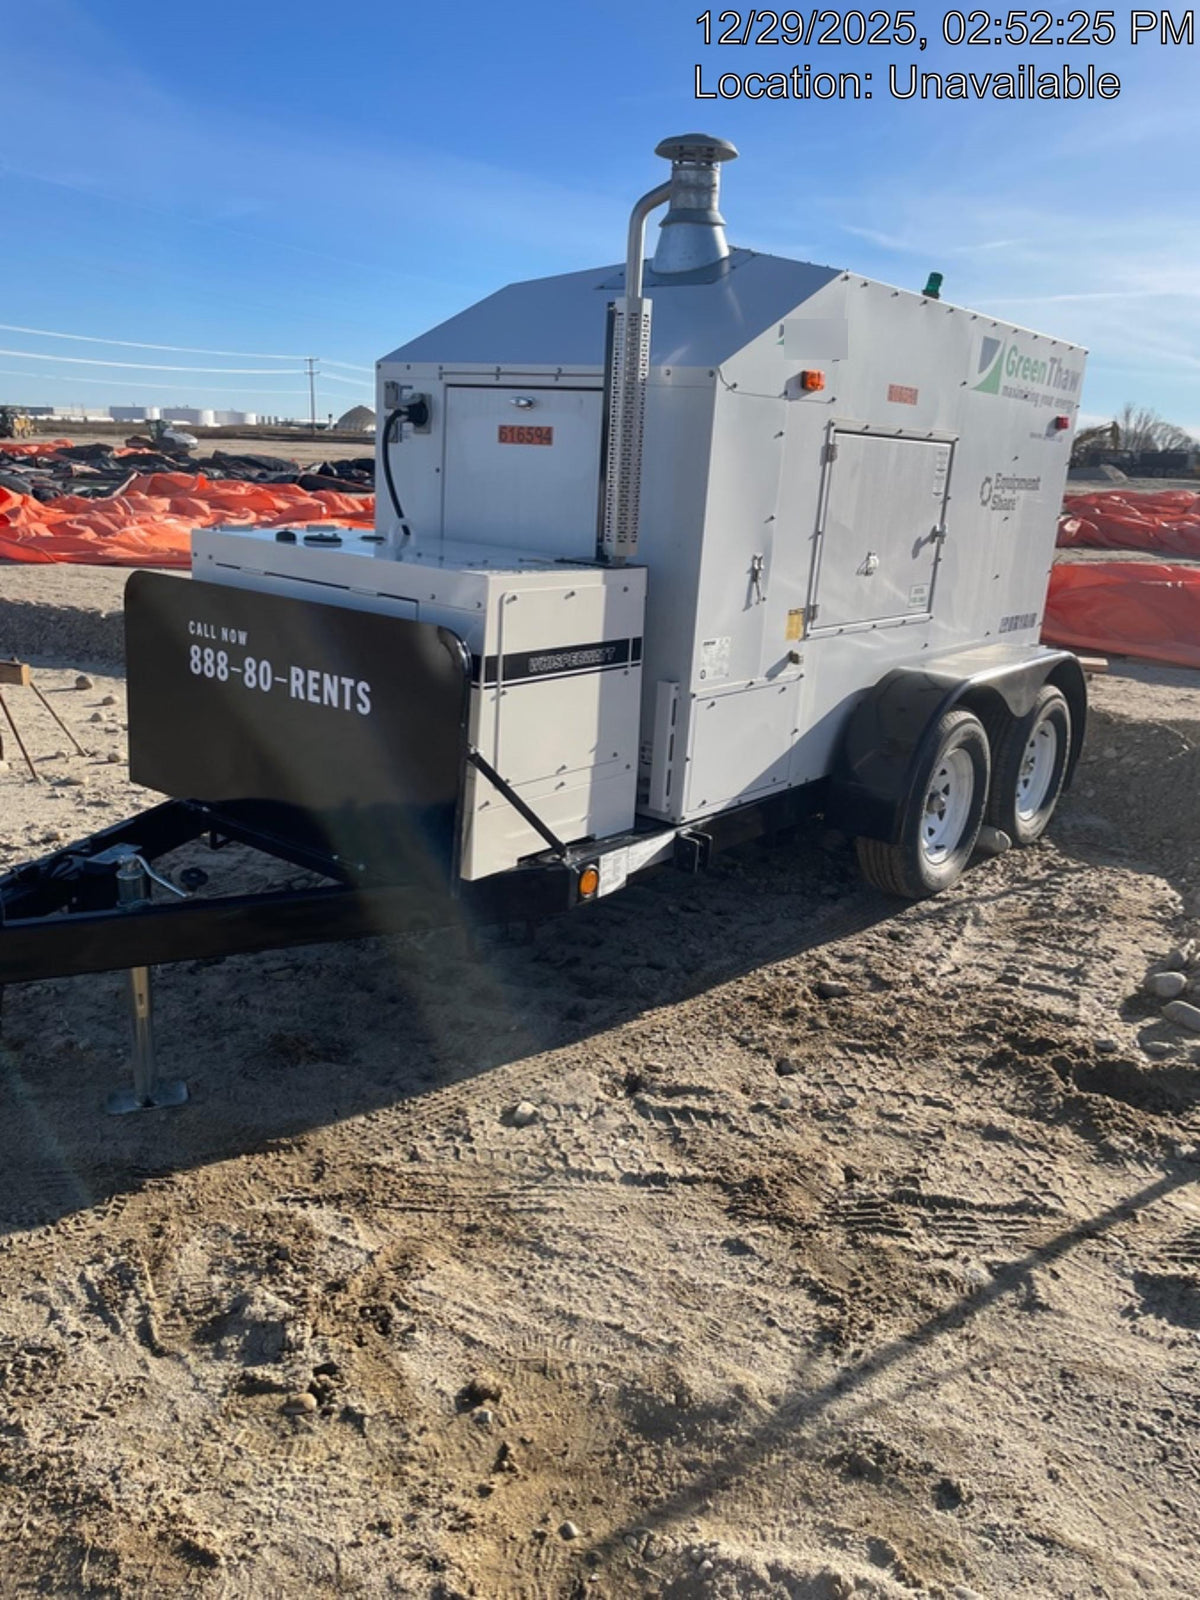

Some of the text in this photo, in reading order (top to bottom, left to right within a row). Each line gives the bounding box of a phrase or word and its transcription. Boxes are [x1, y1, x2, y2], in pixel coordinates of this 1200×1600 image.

[498, 425, 553, 445] 616594
[188, 620, 249, 647] CALL NOW
[189, 644, 371, 716] 888-80-RENTS
